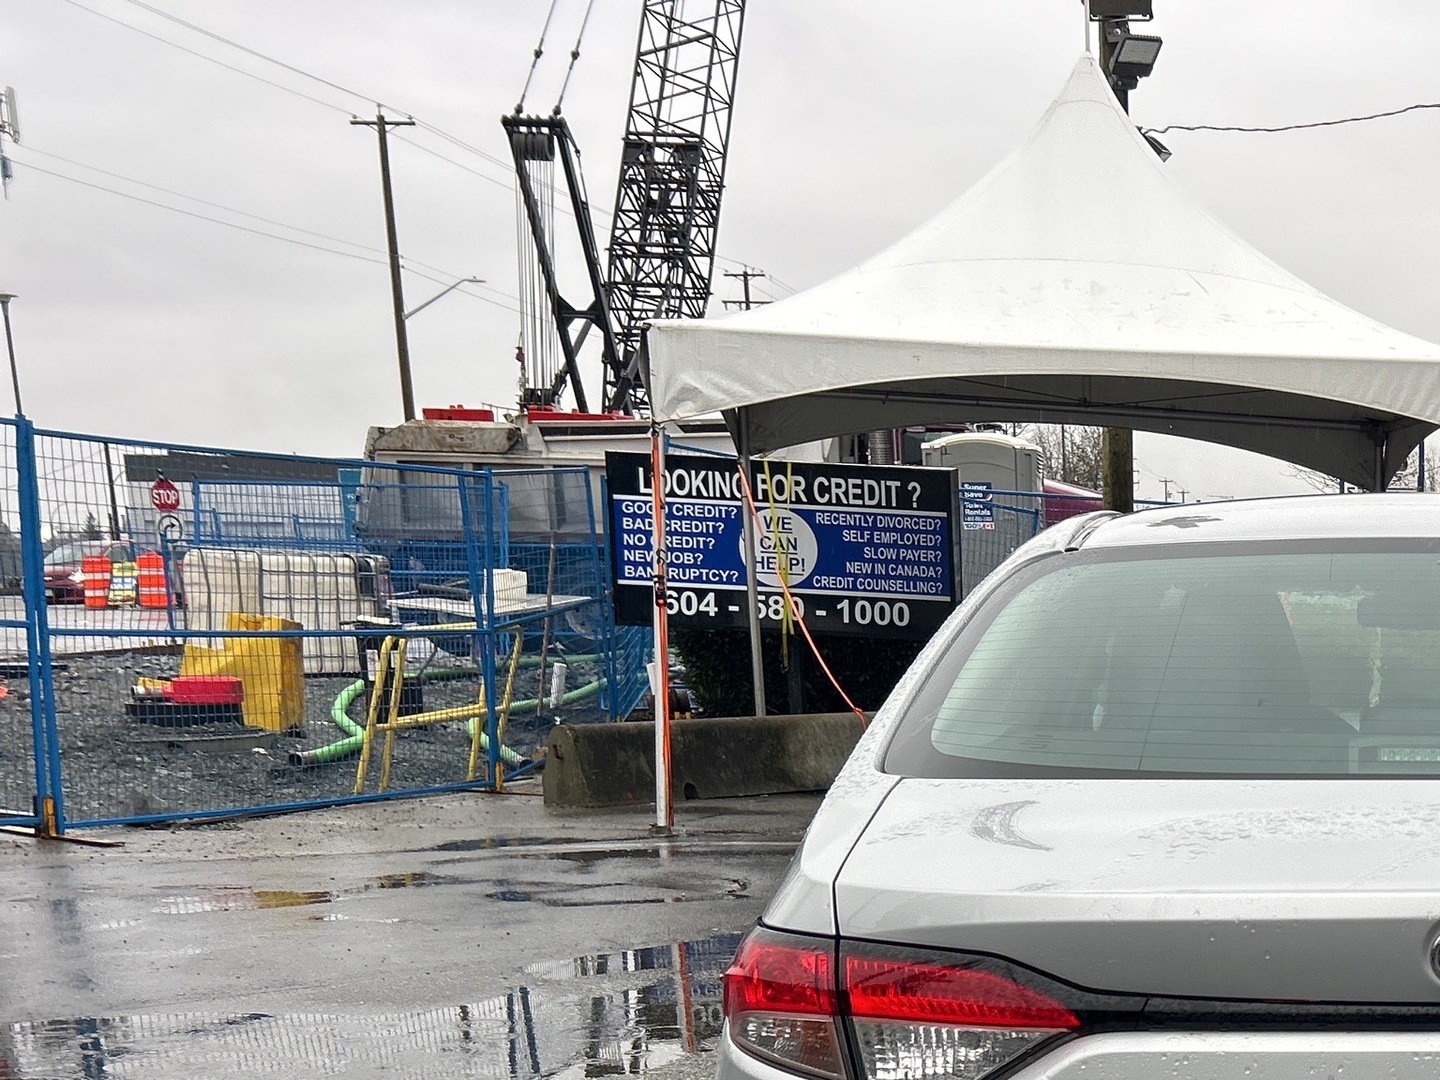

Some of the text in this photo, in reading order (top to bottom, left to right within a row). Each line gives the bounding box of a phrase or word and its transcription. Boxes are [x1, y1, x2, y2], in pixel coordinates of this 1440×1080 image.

[152, 489, 178, 504] STOP
[756, 473, 808, 502] FOR
[813, 476, 901, 507] CREDIT
[672, 504, 738, 519] CREDIT?
[622, 517, 654, 530] BAD
[763, 515, 792, 530] WE
[816, 512, 941, 531] RECENTLY DIVORCED?
[623, 533, 715, 549] NO REDIT?
[760, 535, 798, 551] CAN
[842, 529, 942, 546] SELF EMPLOYED?
[666, 551, 703, 565] JOB?
[863, 546, 942, 562] SLOW PAYER?
[755, 556, 805, 572] HEP!
[846, 561, 943, 578] NEW IN CANADA?
[624, 565, 739, 582] BANRUPTCY?
[812, 575, 943, 594] CREDIT COUNSELLING?
[666, 590, 718, 617] 604
[836, 599, 910, 627] 1000
